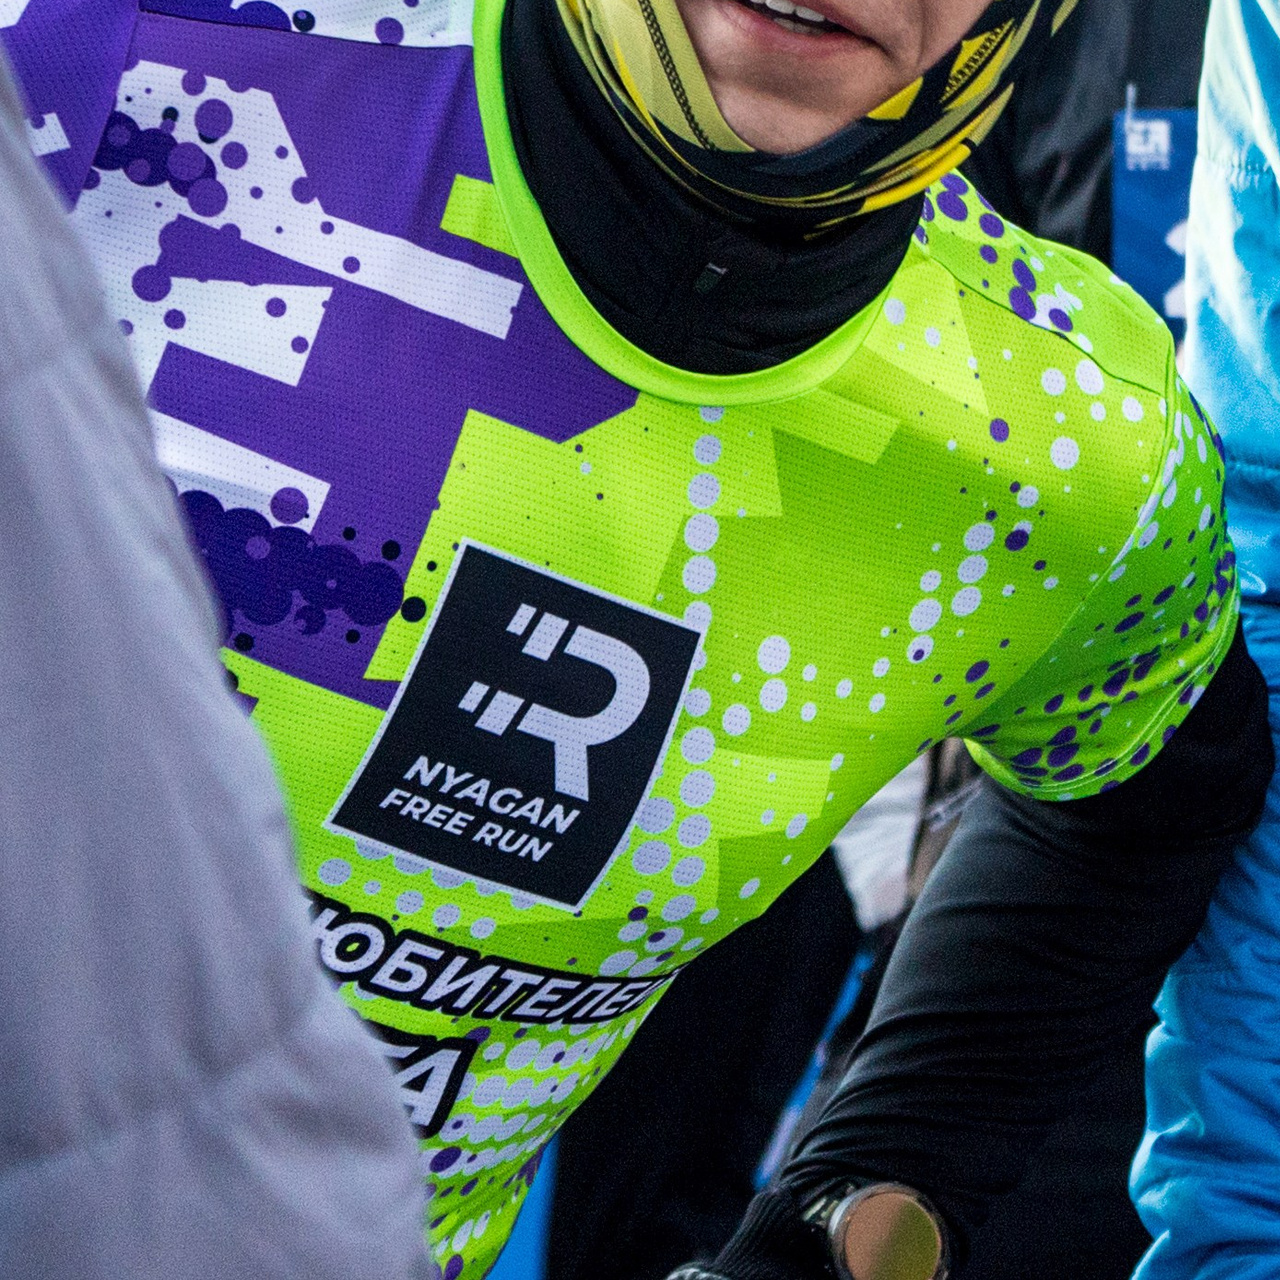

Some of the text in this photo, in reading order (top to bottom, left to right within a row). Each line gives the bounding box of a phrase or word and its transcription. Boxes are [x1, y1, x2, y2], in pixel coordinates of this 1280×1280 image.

[379, 789, 554, 863] FREE RUN
[402, 756, 581, 836] NYAGAN
